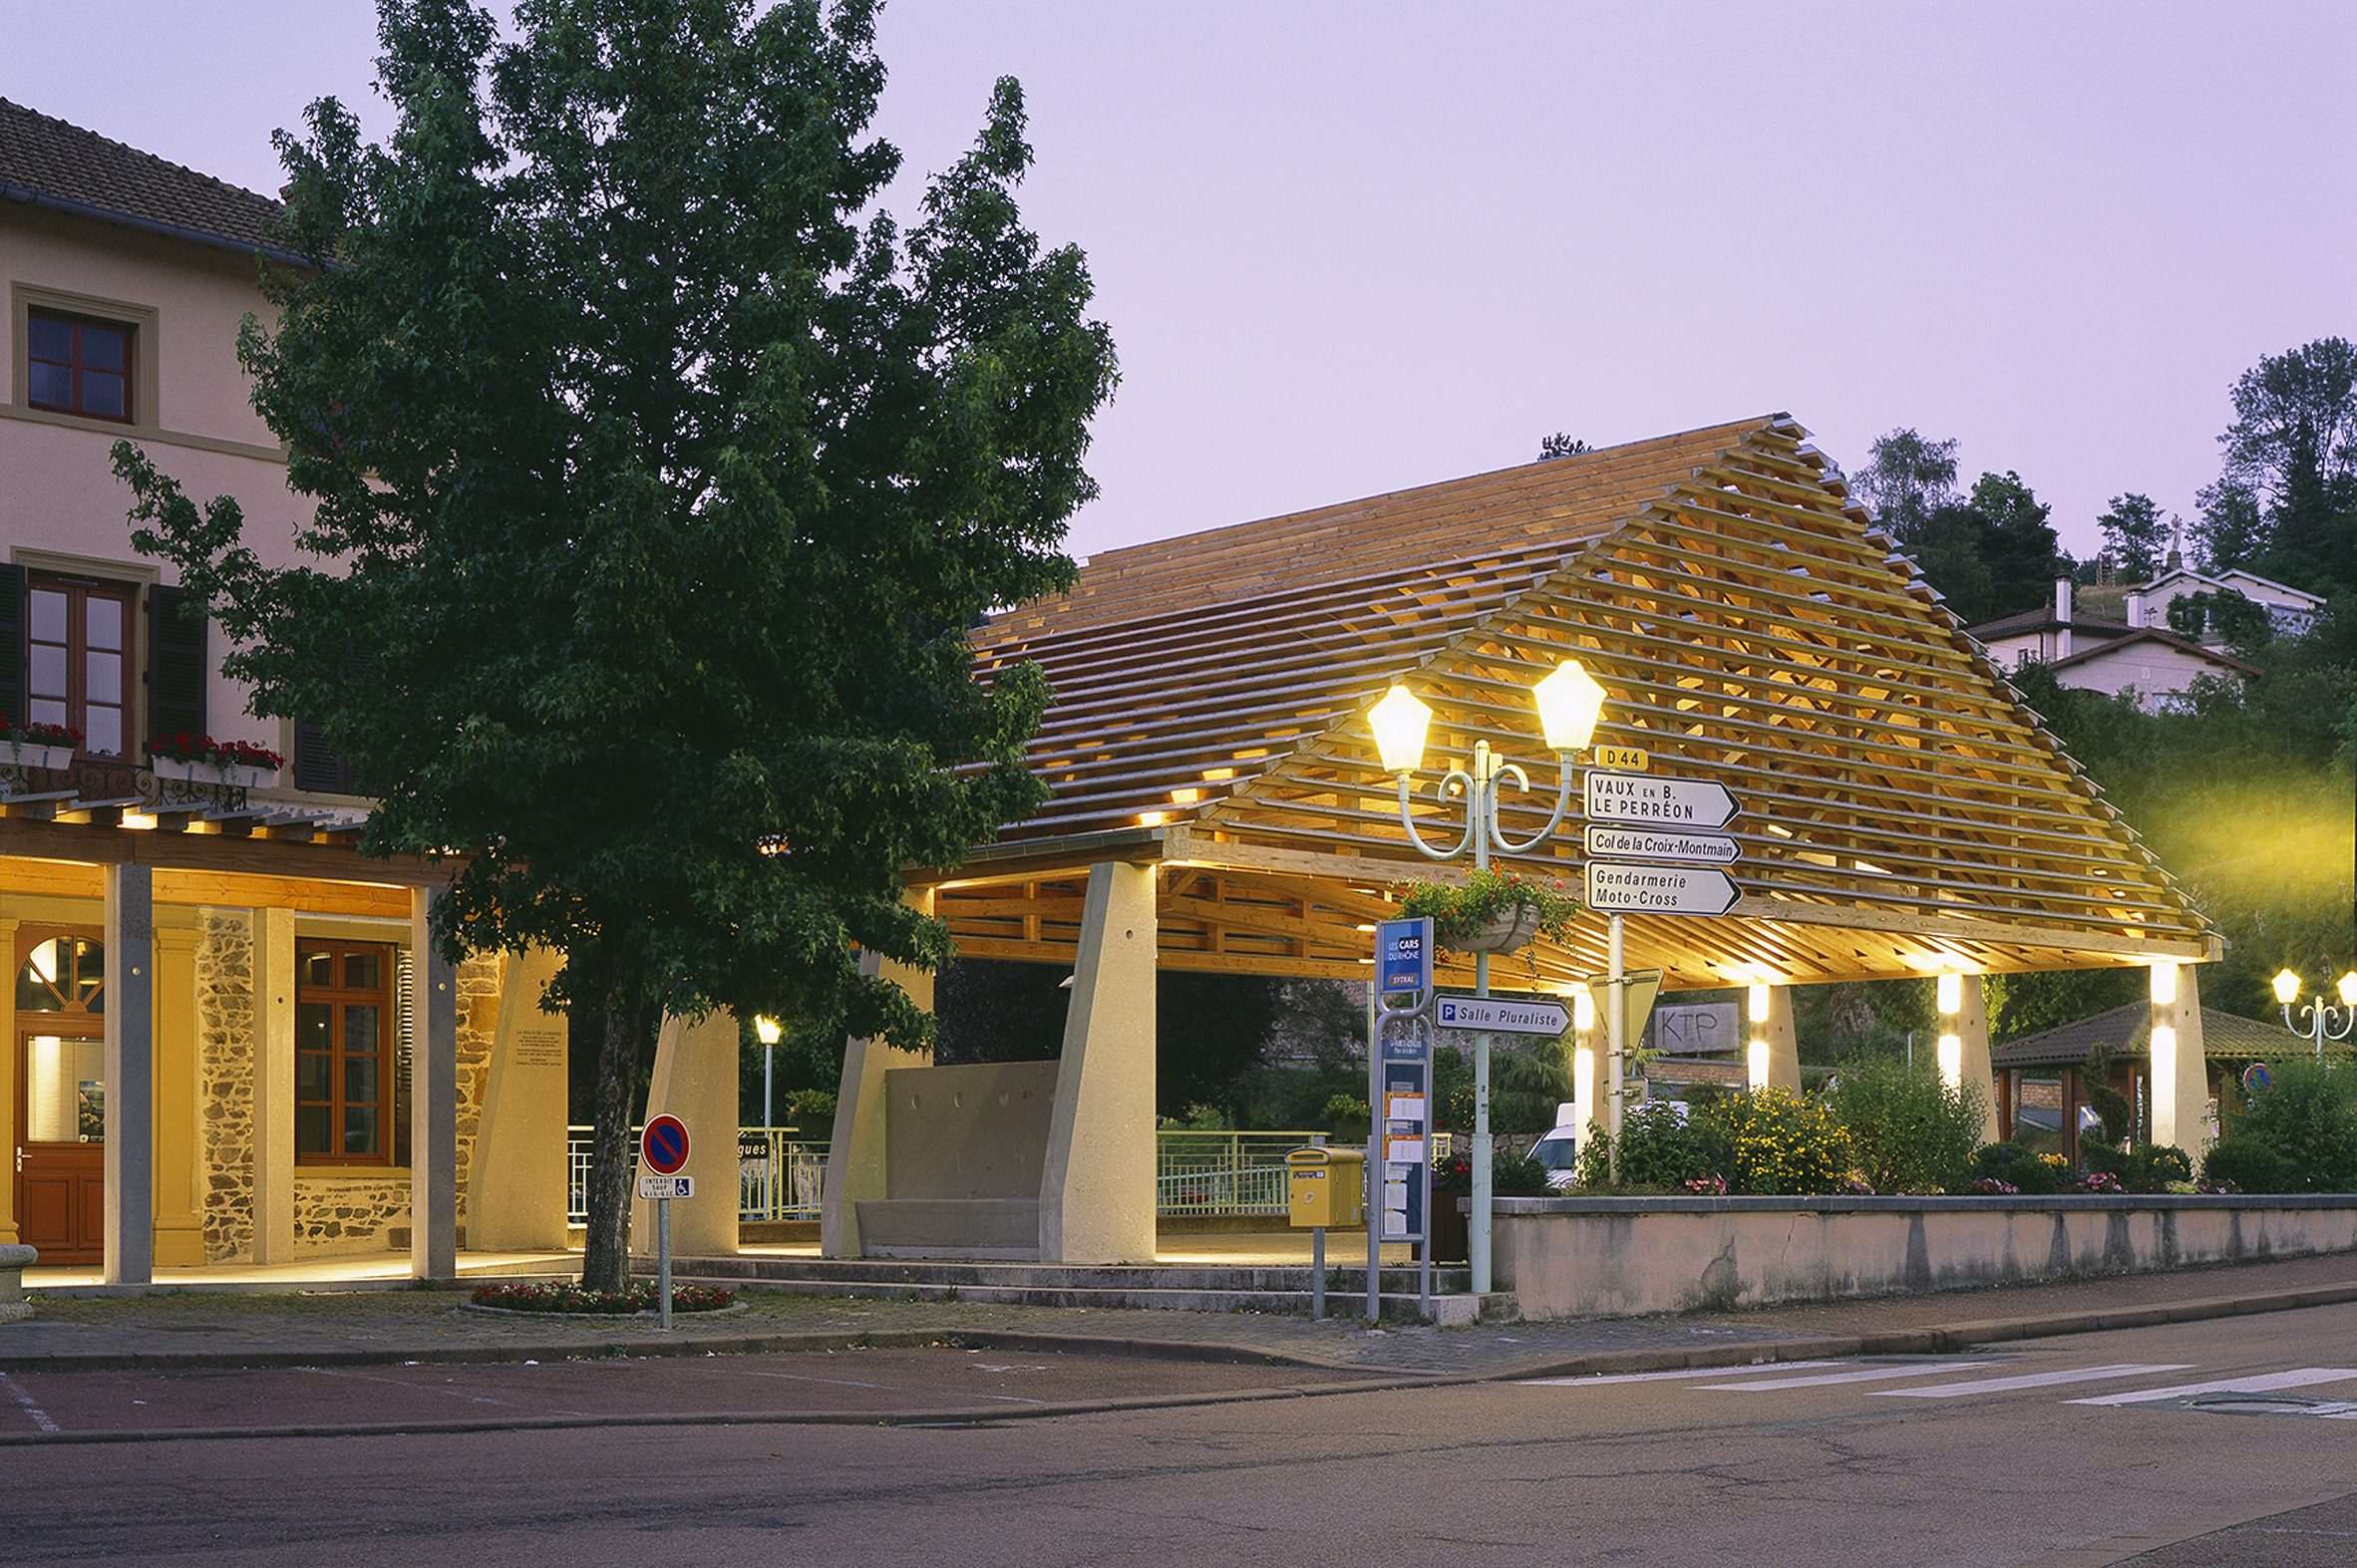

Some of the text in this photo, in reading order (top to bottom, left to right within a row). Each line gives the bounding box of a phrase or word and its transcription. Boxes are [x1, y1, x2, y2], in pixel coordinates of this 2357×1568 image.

[1607, 750, 1639, 767] D 44
[1595, 780, 1676, 799] VAUX EN B.
[1595, 798, 1693, 819] LE PERRÉON
[1595, 833, 1615, 848] Col
[1617, 835, 1630, 849] de
[1632, 836, 1642, 851] la
[1595, 869, 1687, 888] Gendarmerie
[1595, 888, 1679, 906] Moto-Cross
[1399, 939, 1419, 950] CARS
[1388, 949, 1419, 961] DU RHÔNE
[1459, 1007, 1491, 1022] Salle
[1499, 1010, 1558, 1027] Pluraliste
[1661, 1010, 1718, 1045] KTP
